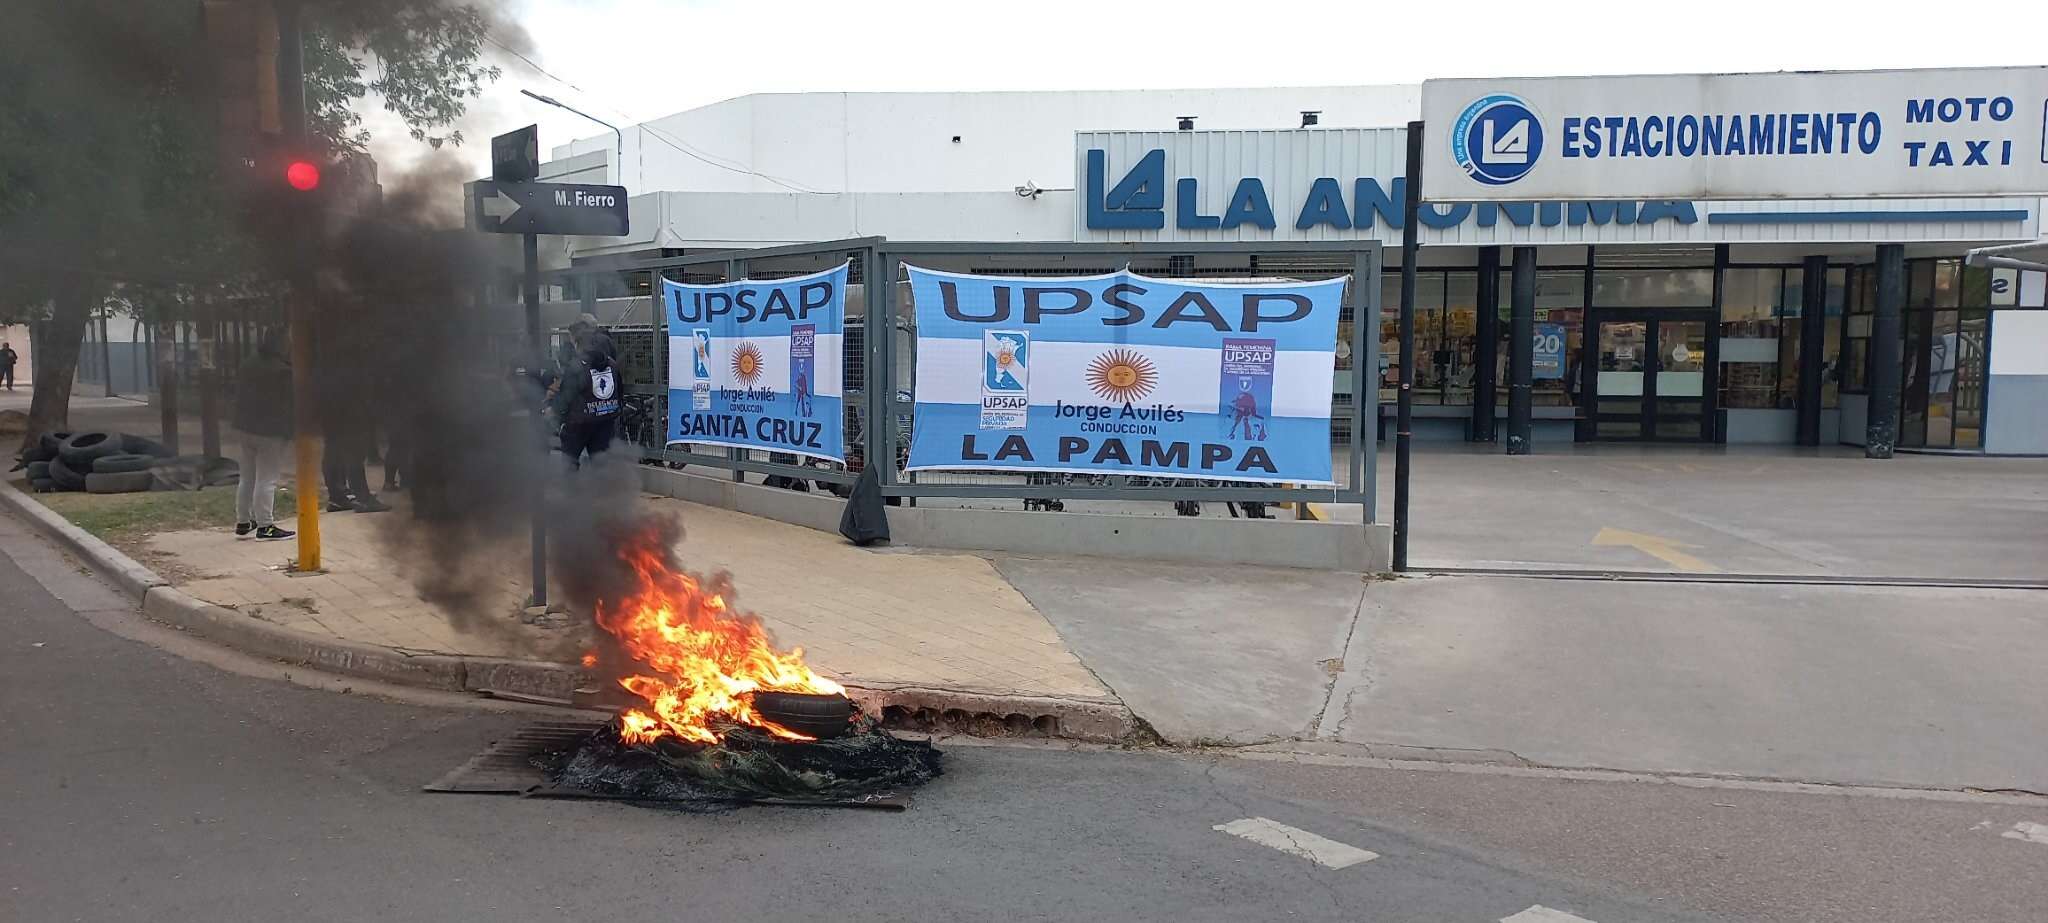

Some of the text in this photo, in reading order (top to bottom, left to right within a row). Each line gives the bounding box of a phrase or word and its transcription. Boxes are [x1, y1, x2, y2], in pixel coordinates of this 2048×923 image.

[1905, 96, 2014, 124] MOTO
[1562, 111, 1882, 158] ESTACIONAMIENTO
[1903, 140, 2012, 167] TAXI
[555, 190, 615, 208] M. Fierro
[1177, 177, 1277, 230] LA
[674, 281, 833, 323] UPSAP
[938, 280, 1313, 332] UPSAP
[1225, 351, 1272, 362] UPSAP
[1533, 334, 1560, 354] 20
[720, 385, 776, 402] Jorge Avilés
[983, 397, 1027, 409] UPSAP
[1055, 399, 1185, 423] Jorge Avilés
[680, 413, 822, 448] SANTA CRUZ
[1080, 422, 1157, 435] CONDUCCION
[961, 434, 1279, 474] LA PAMPA
